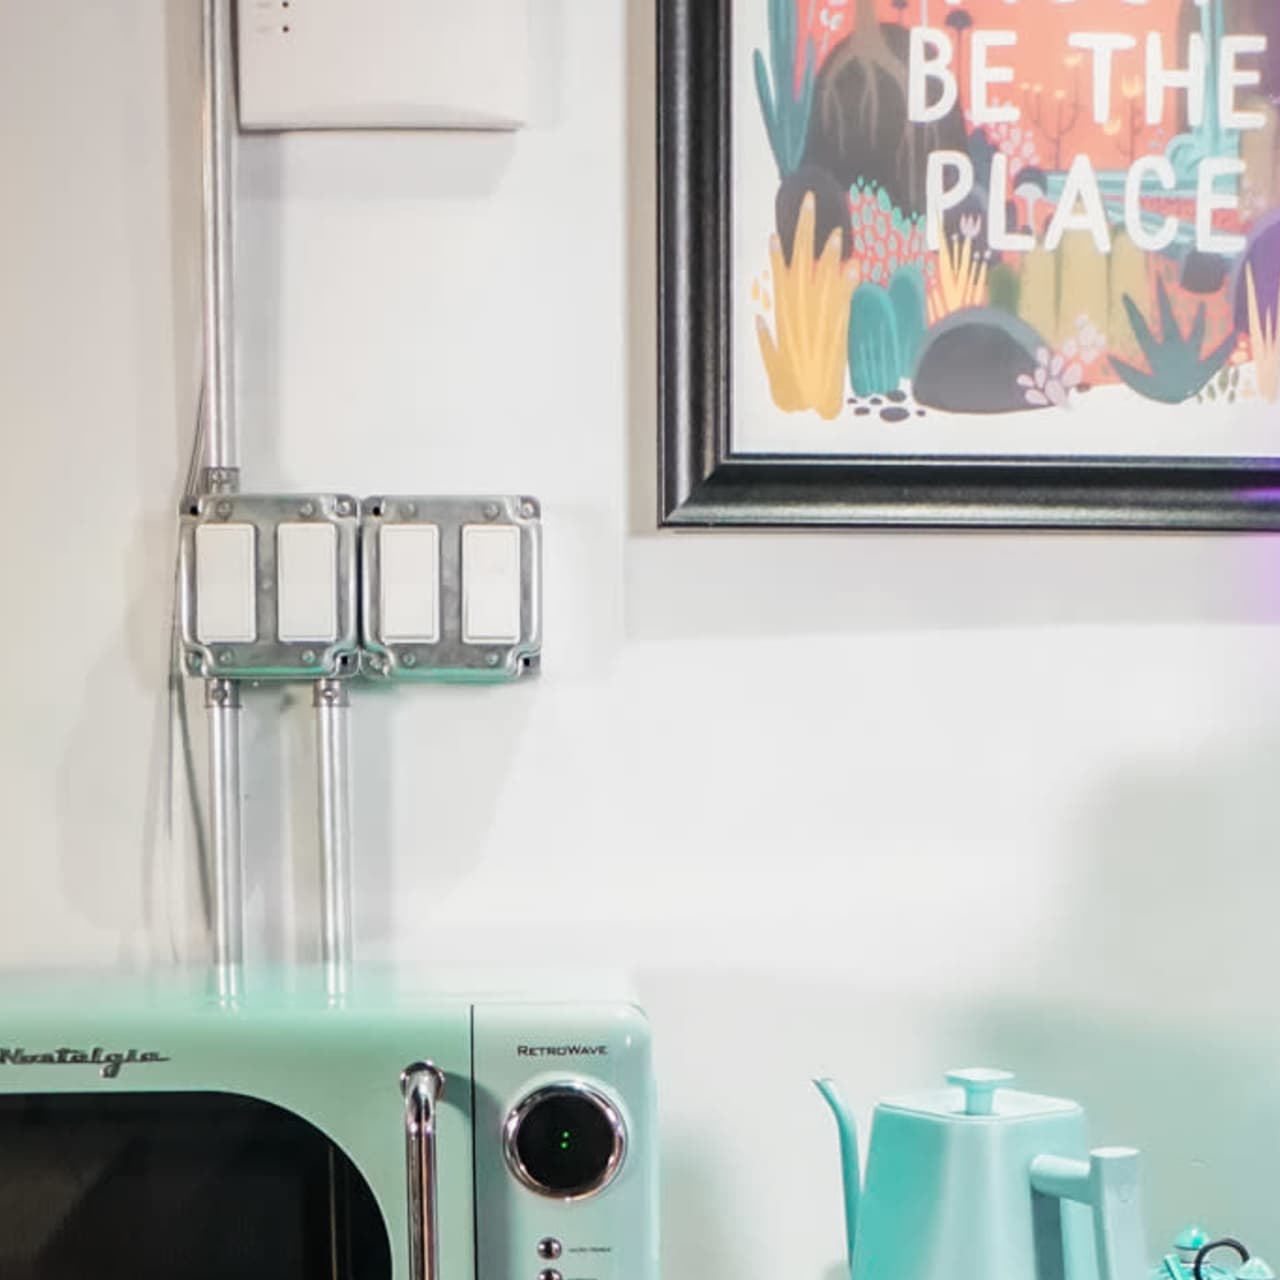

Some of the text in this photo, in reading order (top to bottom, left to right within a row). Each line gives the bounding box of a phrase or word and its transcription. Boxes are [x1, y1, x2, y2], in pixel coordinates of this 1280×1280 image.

[907, 27, 1268, 129] BE THE
[925, 151, 1247, 253] PLACE
